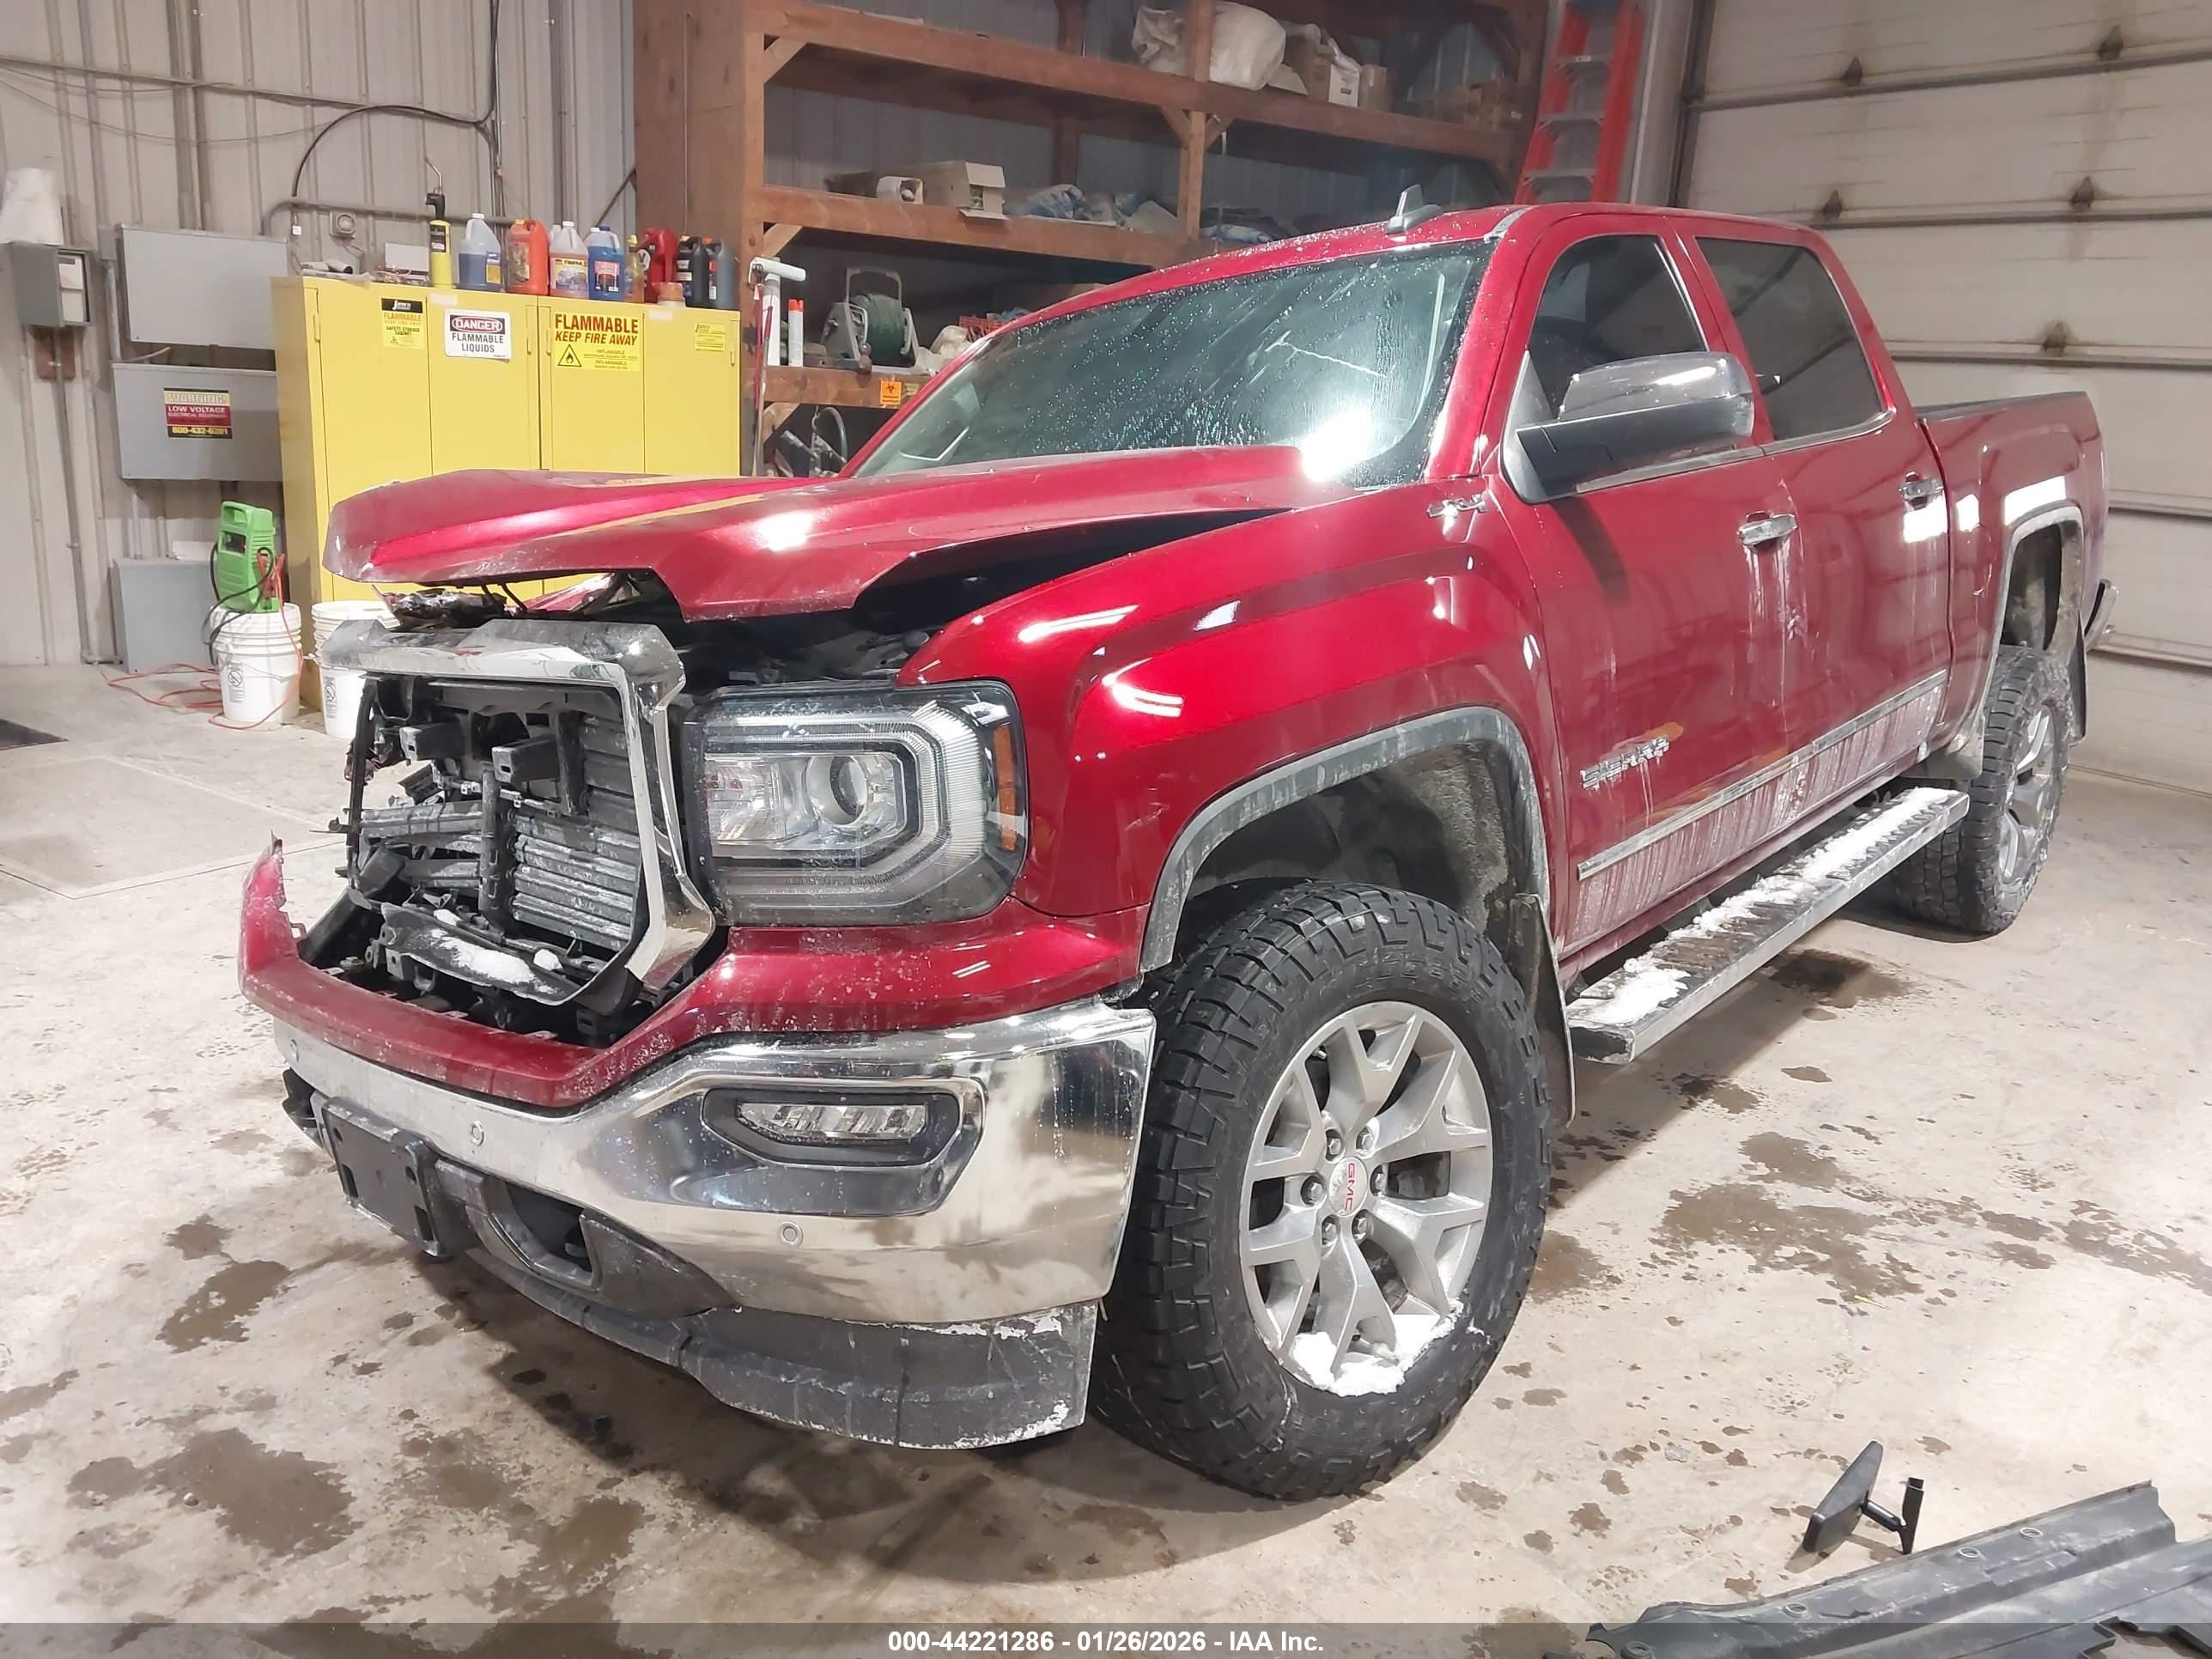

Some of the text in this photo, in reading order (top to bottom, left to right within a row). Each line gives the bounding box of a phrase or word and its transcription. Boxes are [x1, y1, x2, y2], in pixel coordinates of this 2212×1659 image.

[384, 313, 422, 321] FLAMMABLE
[455, 319, 499, 331] DANGER
[555, 313, 638, 334] FLAMMABLE
[452, 332, 504, 343] FLAMMABLE
[555, 331, 638, 346] KEEP FIRE AWAY
[461, 343, 495, 353] LIQUIDS
[168, 392, 225, 404] WARNING
[1345, 1163, 1356, 1211] GMC
